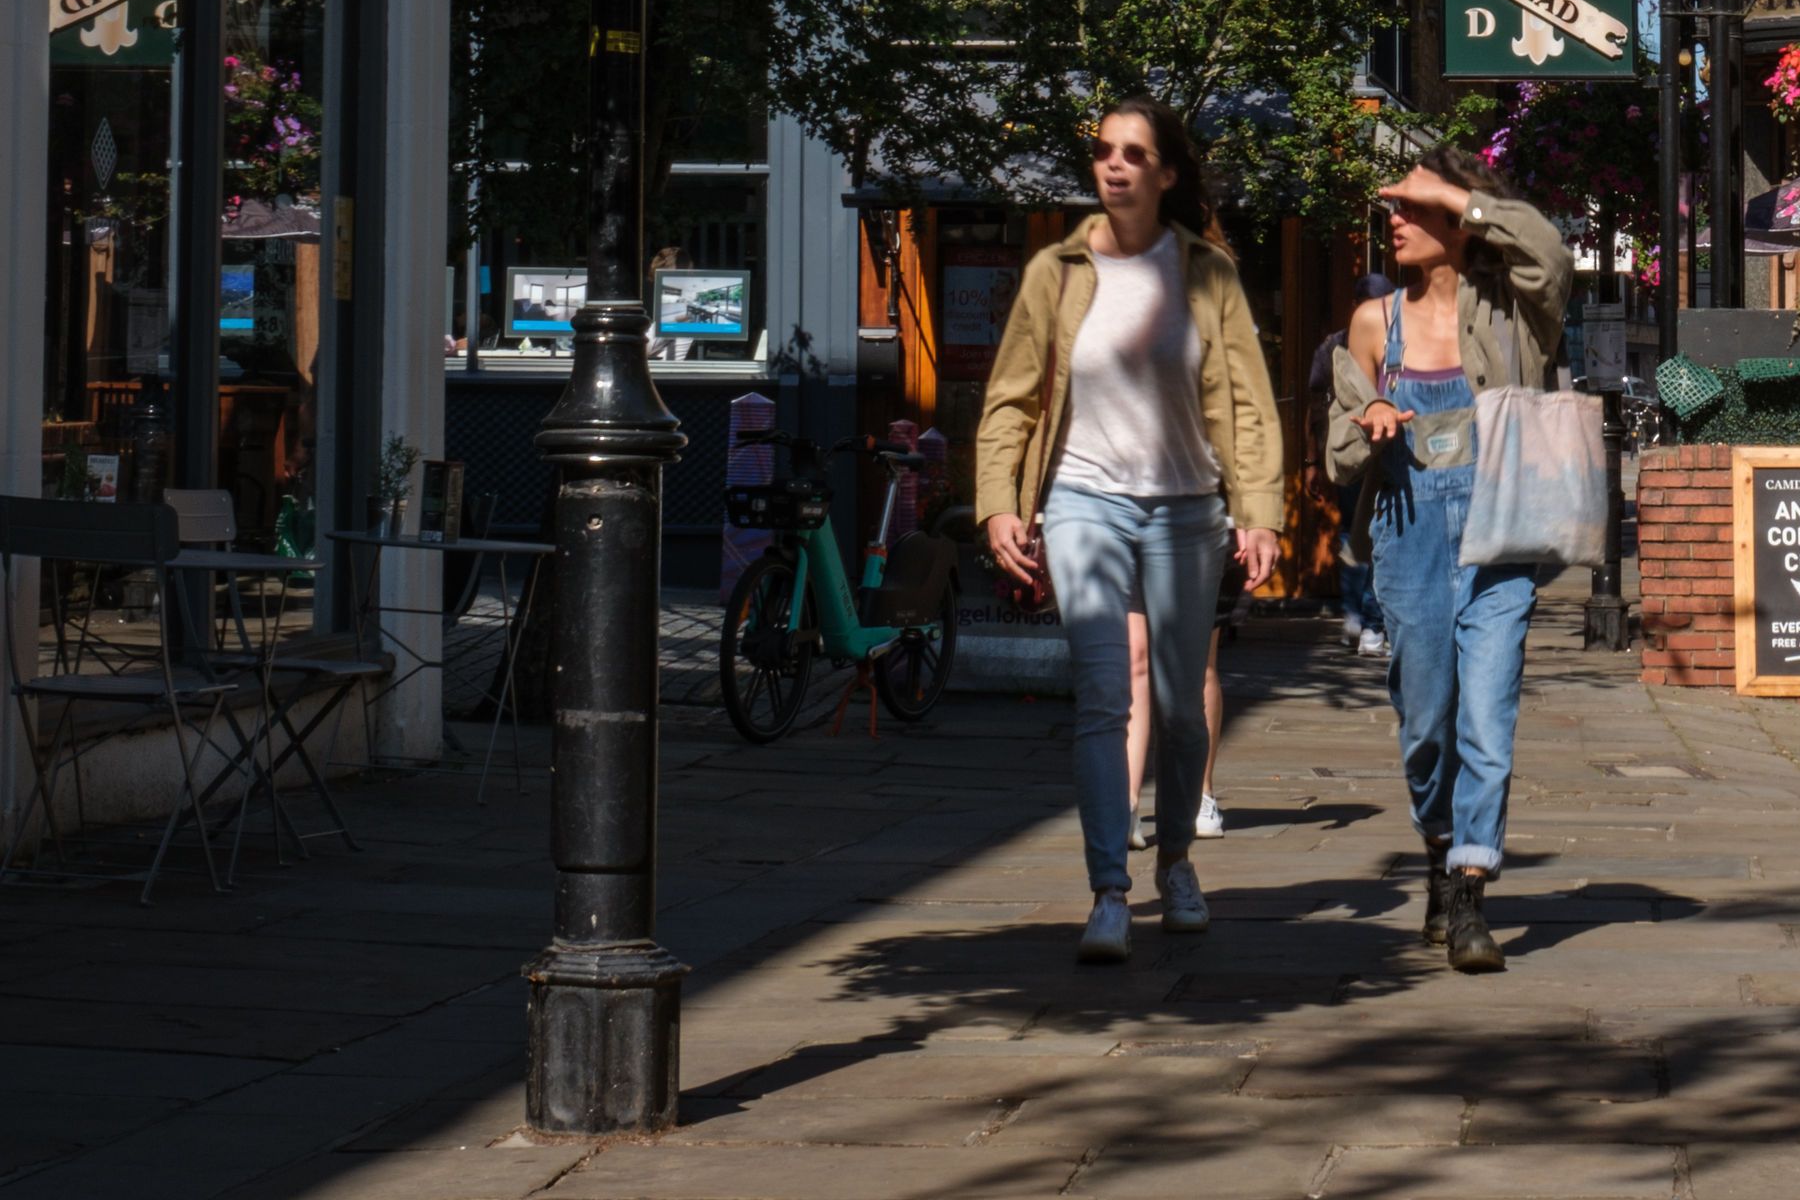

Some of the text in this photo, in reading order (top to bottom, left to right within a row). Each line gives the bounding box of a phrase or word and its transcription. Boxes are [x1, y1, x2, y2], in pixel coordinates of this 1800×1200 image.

[1464, 7, 1497, 38] D
[947, 289, 988, 306] 10%
[1771, 638, 1797, 648] FREE
